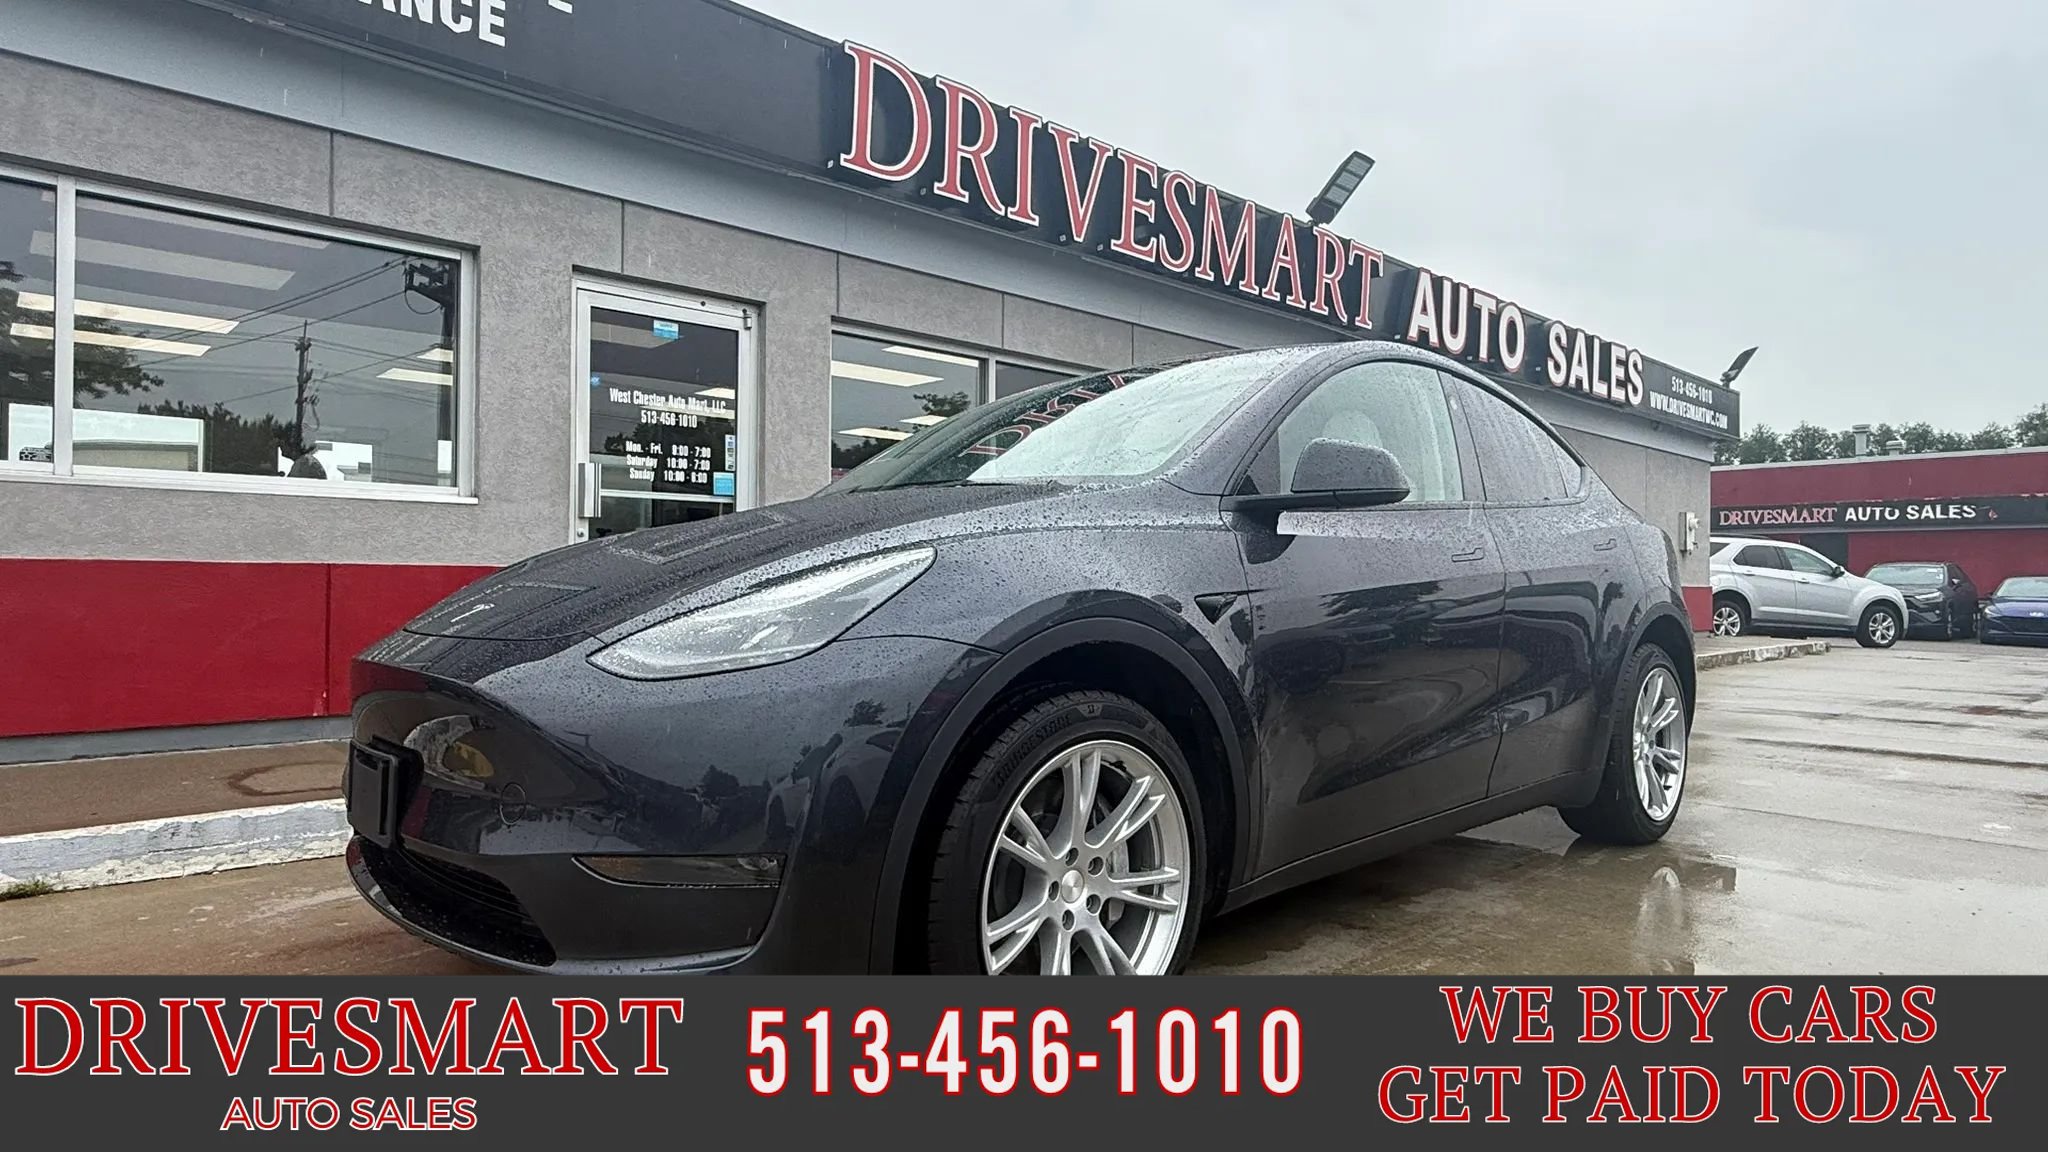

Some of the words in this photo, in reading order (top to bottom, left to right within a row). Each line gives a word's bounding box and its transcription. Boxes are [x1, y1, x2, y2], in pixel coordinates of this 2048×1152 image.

[358, 0, 506, 47] CE
[839, 40, 1384, 330] DRIVESMART
[1407, 267, 1526, 373] AUTO
[1547, 320, 1645, 407] SALES
[609, 388, 631, 404] West
[633, 390, 666, 407] Chester
[668, 394, 686, 410] Auto
[711, 399, 727, 414] LLC
[640, 410, 698, 428] 513-456-1010
[625, 440, 644, 452] Mon.
[650, 442, 663, 455] Fri.
[626, 454, 658, 469] Saturday
[629, 467, 655, 482] Sunday
[1719, 507, 1837, 526] DRIVESMART
[1845, 506, 1901, 522] AUTO
[1905, 504, 1977, 520] SALES
